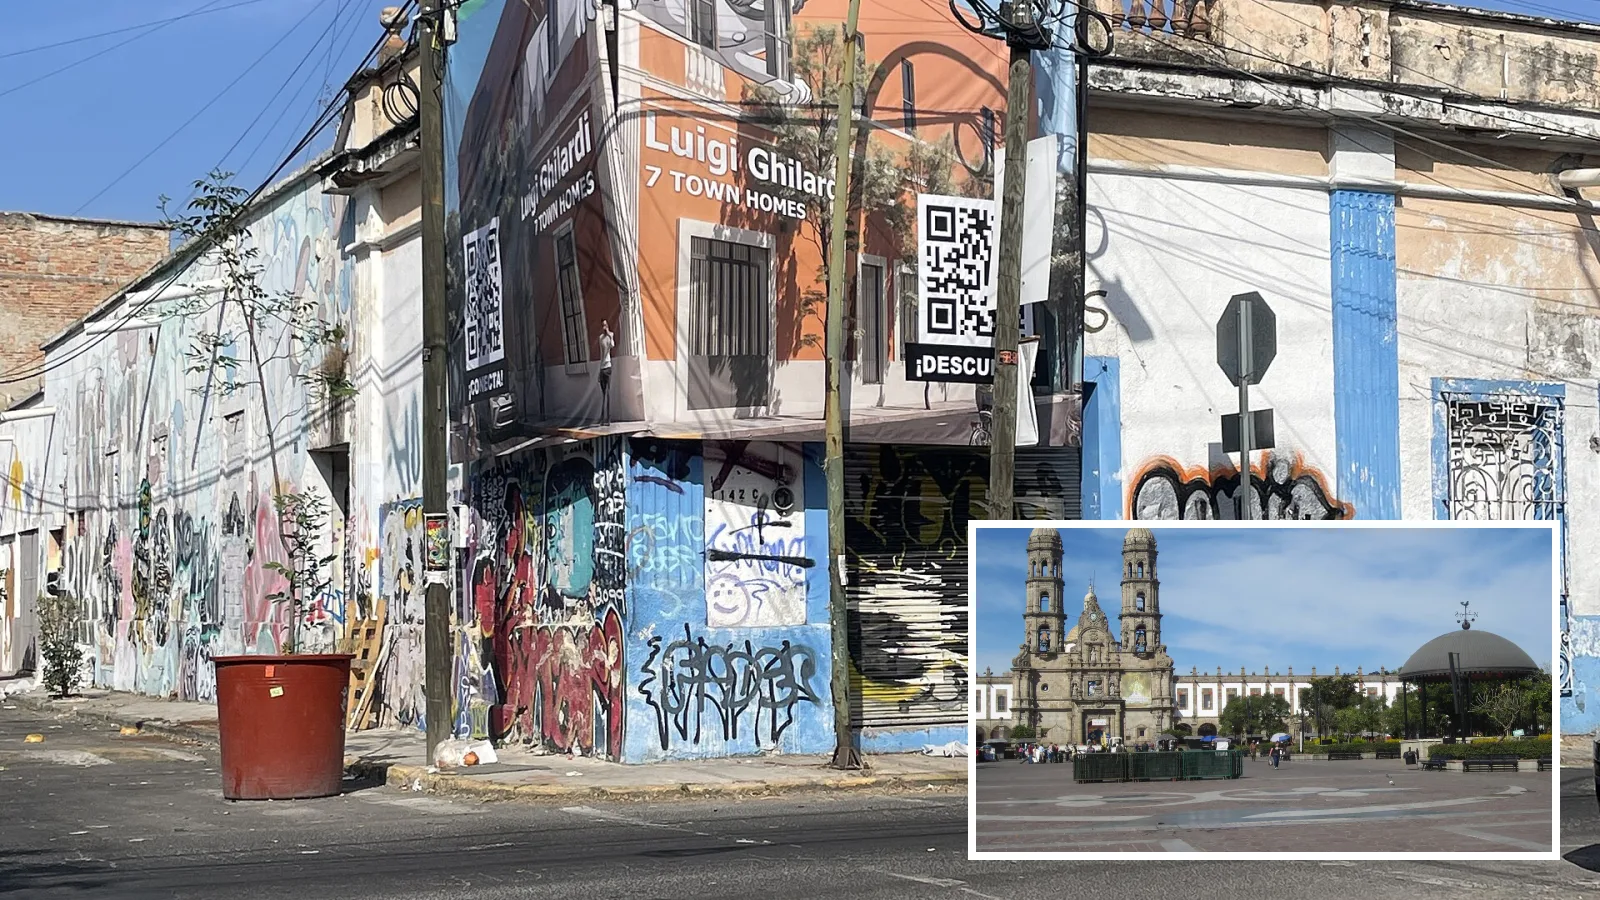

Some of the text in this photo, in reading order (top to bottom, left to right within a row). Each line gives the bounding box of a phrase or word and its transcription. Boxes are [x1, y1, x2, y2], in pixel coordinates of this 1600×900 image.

[521, 111, 592, 221] Luigi Ghilardi
[645, 110, 738, 176] Luigi
[534, 170, 595, 236] 7 TOWN HOMES
[645, 165, 807, 220] 7 TOWN HOMES
[468, 369, 504, 401] ¡CONECTA!
[916, 354, 992, 378] ¡DESCU
